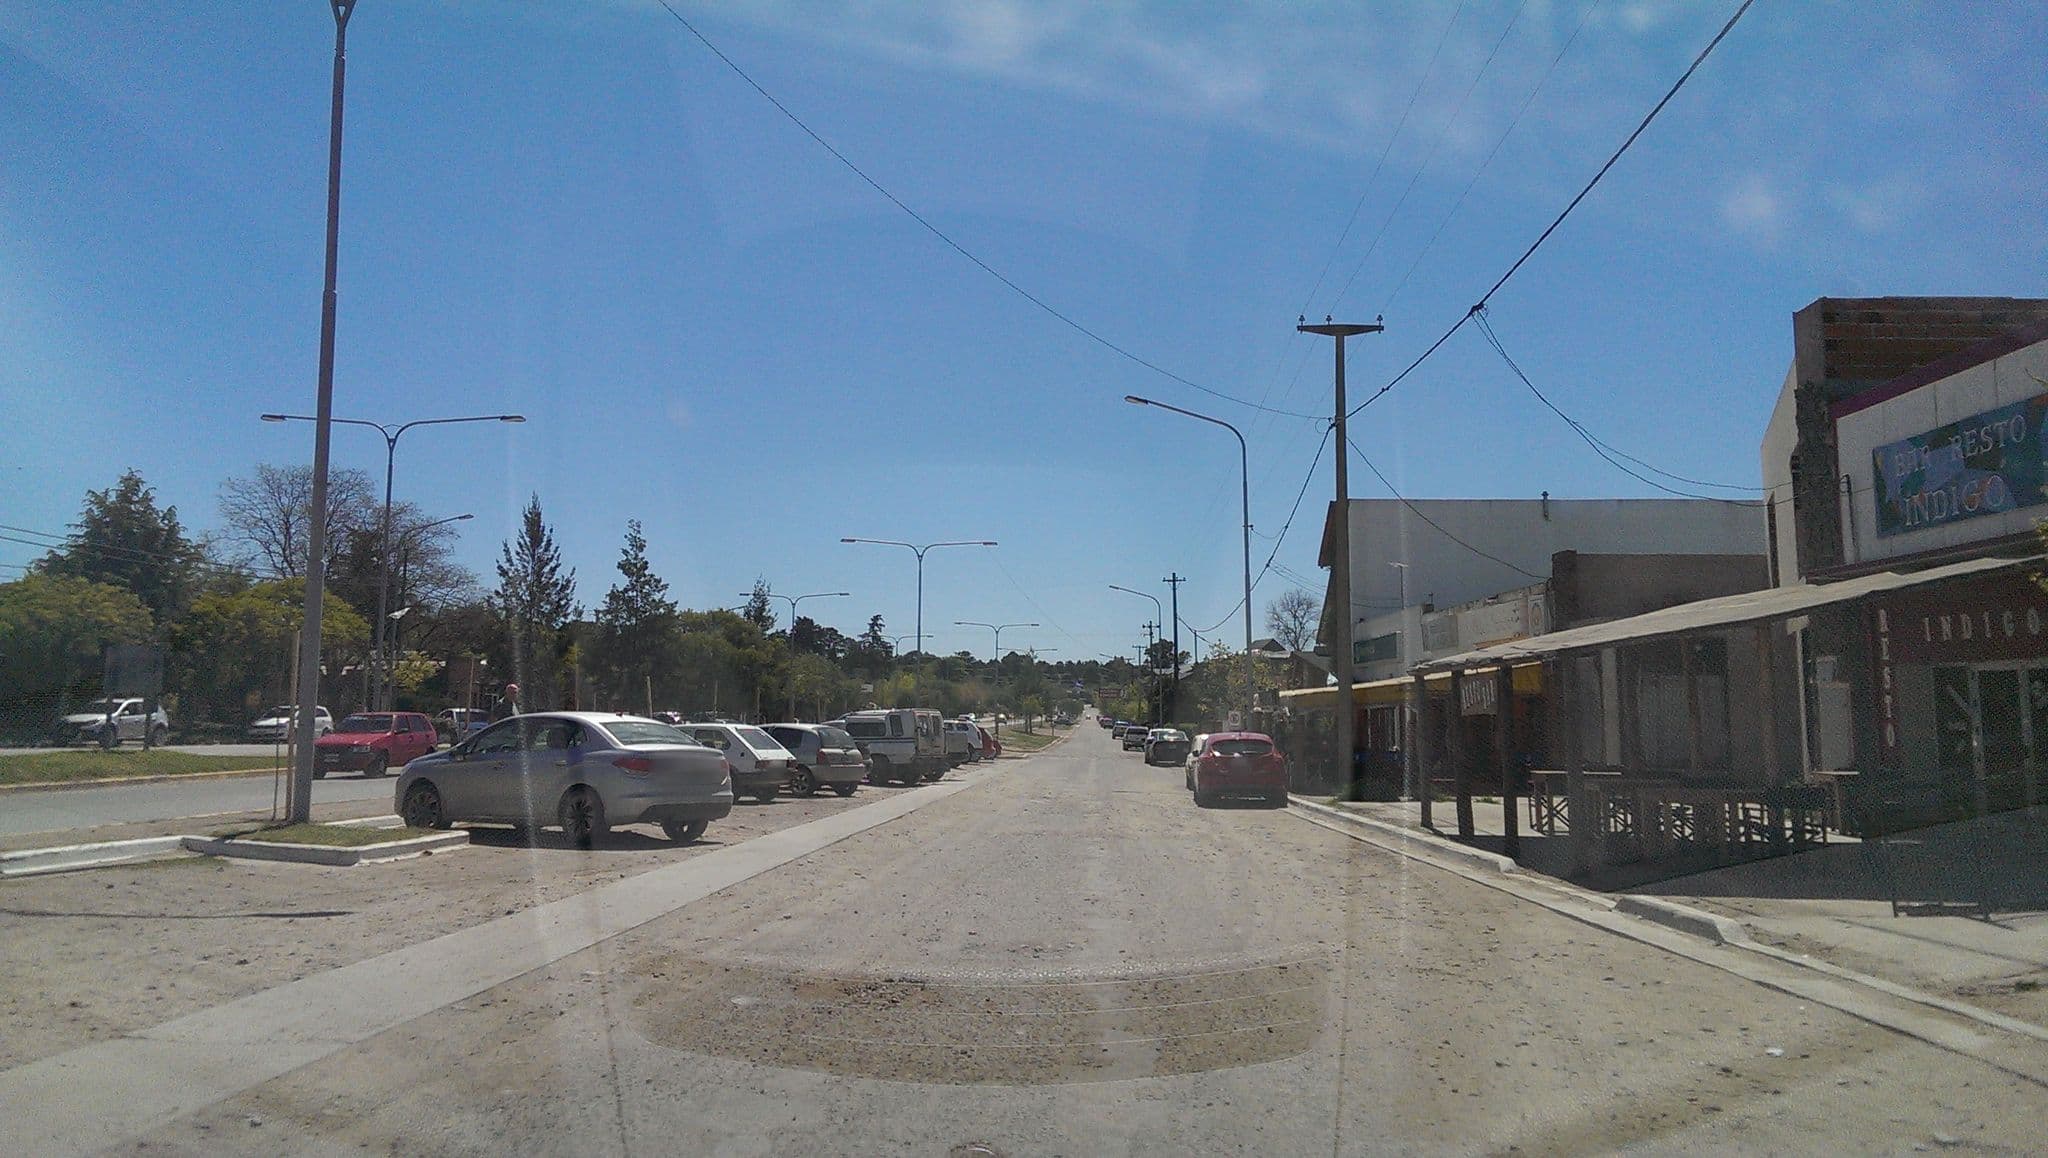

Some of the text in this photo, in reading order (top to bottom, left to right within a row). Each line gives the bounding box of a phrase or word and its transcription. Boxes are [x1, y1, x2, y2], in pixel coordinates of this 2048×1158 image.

[1949, 414, 2026, 460] RESTO
[1903, 474, 2004, 526] INDIGO
[1923, 608, 2040, 642] INDIGO
[1878, 608, 1896, 748] RESTO
